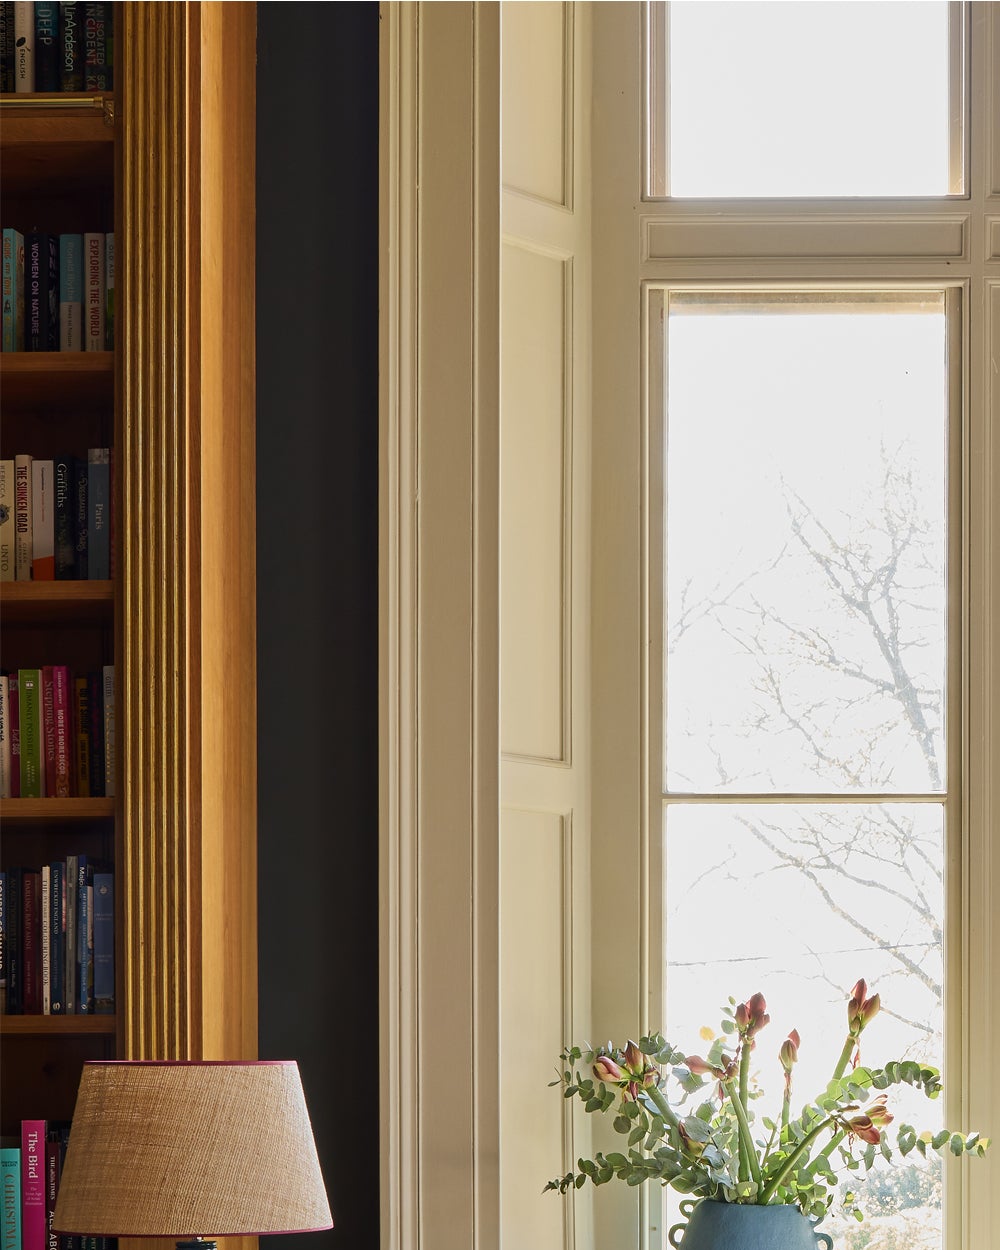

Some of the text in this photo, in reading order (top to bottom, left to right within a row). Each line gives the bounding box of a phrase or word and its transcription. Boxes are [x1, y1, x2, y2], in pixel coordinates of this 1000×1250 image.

[38, 9, 52, 45] DEEP
[86, 4, 95, 65] INCIDENT
[96, 21, 104, 65] ISOLATED
[32, 281, 39, 295] ON
[90, 240, 100, 336] EXPLORING THE WORLD
[17, 466, 27, 533] THE SUNKEN ROAD
[56, 463, 69, 509] Griffiths
[95, 503, 103, 530] Paris
[44, 681, 55, 761] Stepping Stones
[28, 1131, 38, 1178] The Bird
